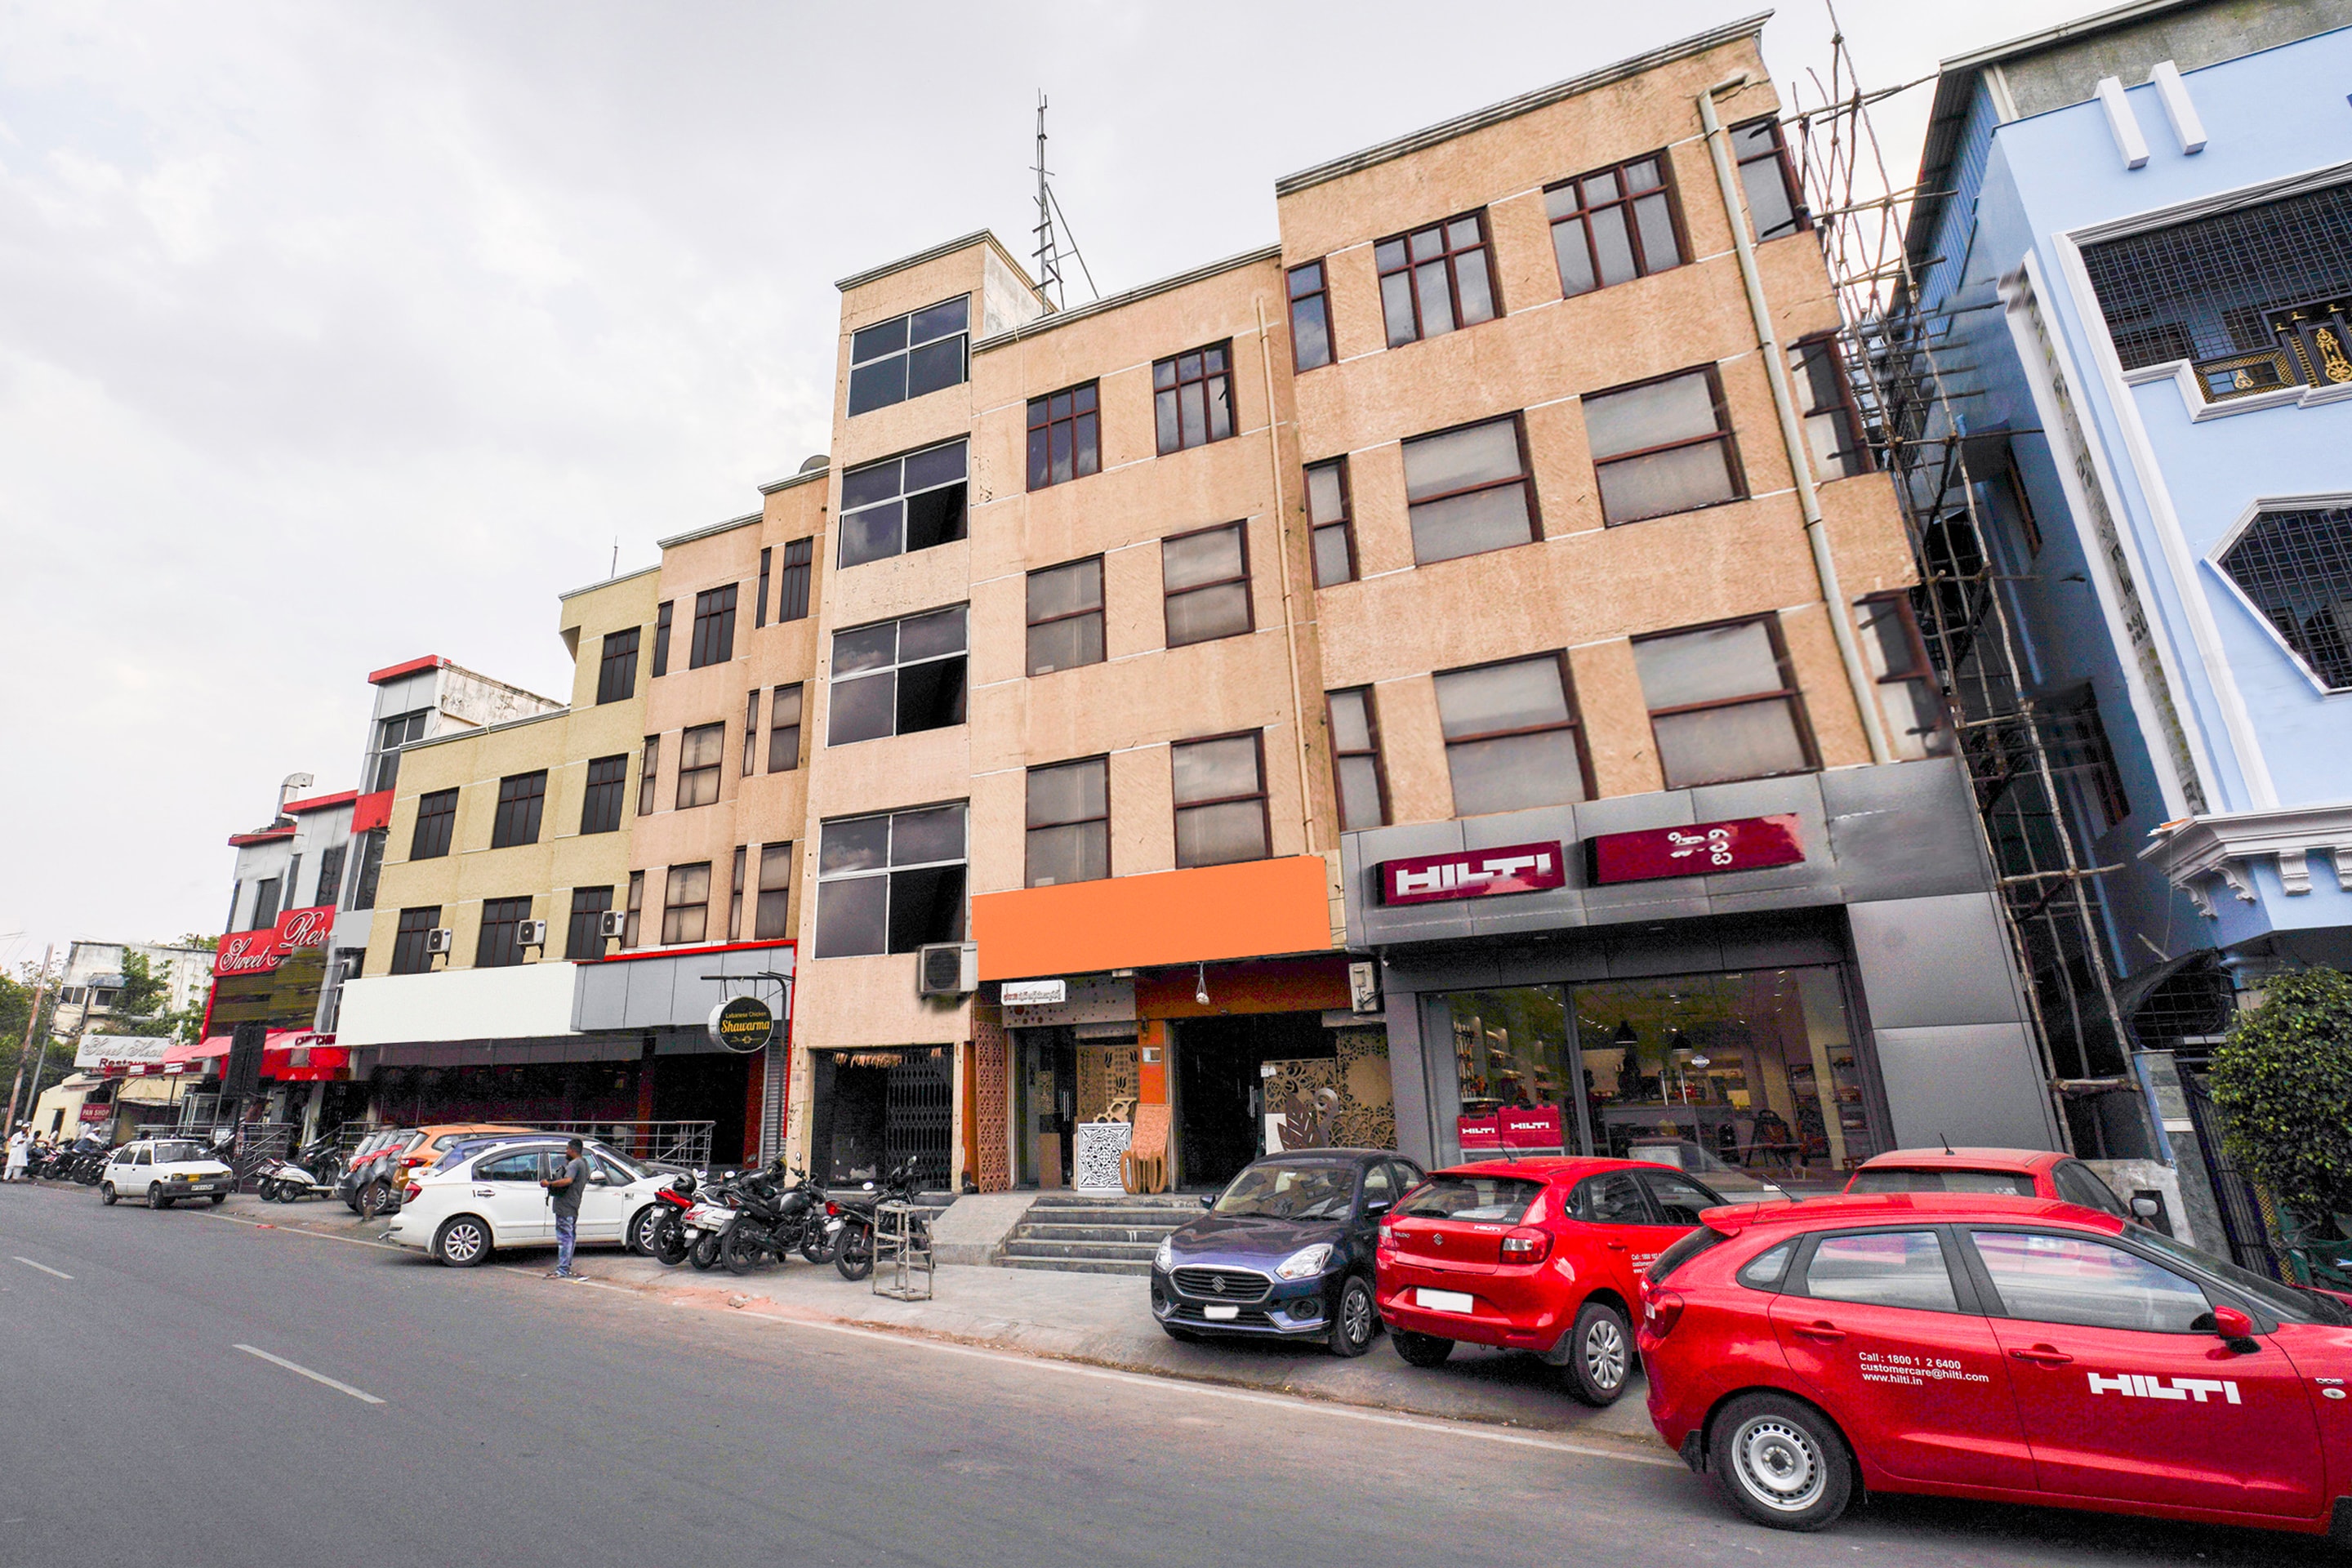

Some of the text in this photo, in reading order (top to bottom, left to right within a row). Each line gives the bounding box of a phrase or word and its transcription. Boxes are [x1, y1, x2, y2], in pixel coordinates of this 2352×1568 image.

[1396, 853, 1552, 897] HILTI
[219, 938, 272, 972] Sweet
[720, 1019, 770, 1033] Shawarma
[83, 1036, 123, 1056] Sweet
[1510, 1121, 1550, 1129] HILTI
[1859, 1352, 1878, 1361] Call
[1887, 1354, 1911, 1365] 1800
[1936, 1358, 1961, 1370] 6400
[1860, 1363, 1989, 1383] customercare@hilti.com
[1862, 1373, 1923, 1386] www.hilti.in
[2087, 1372, 2242, 1405] HILTI
